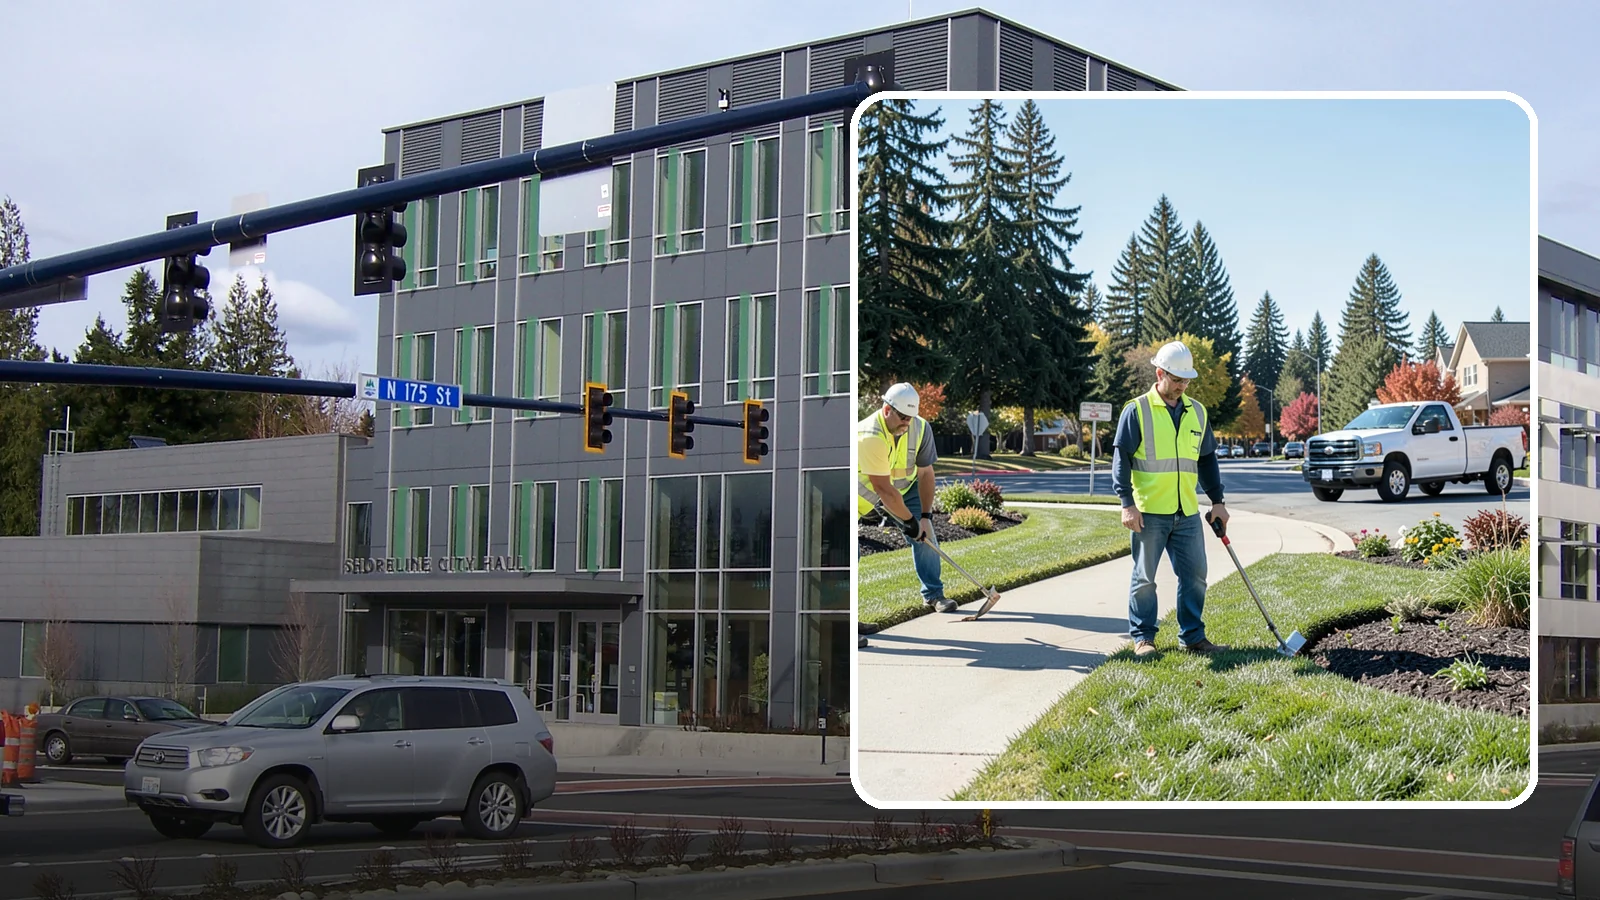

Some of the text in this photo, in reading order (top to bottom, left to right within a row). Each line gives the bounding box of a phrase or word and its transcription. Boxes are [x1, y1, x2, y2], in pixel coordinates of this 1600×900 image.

[387, 380, 452, 405] N 175 St
[344, 555, 525, 574] SHORELINE CITY HALL
